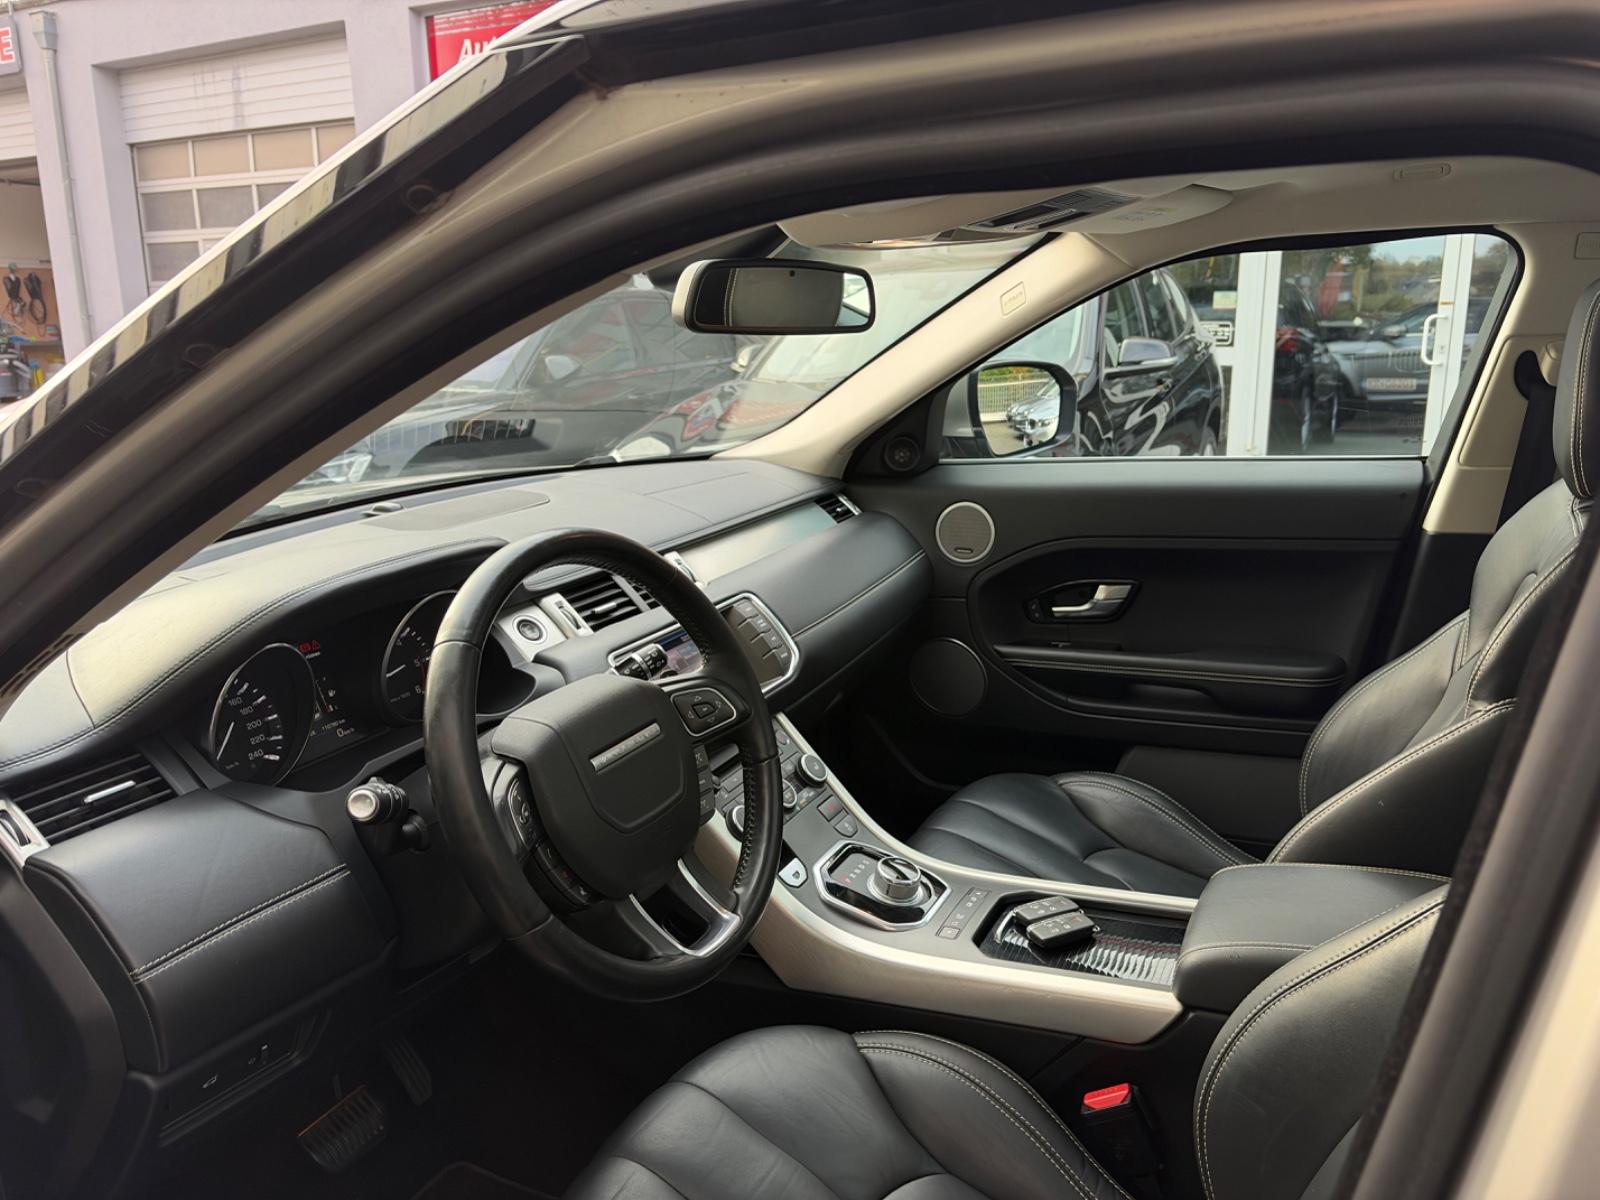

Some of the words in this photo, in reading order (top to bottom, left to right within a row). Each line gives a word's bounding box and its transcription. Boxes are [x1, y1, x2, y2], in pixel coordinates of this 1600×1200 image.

[246, 719, 262, 730] 200
[249, 733, 266, 745] 220
[248, 748, 264, 761] 240
